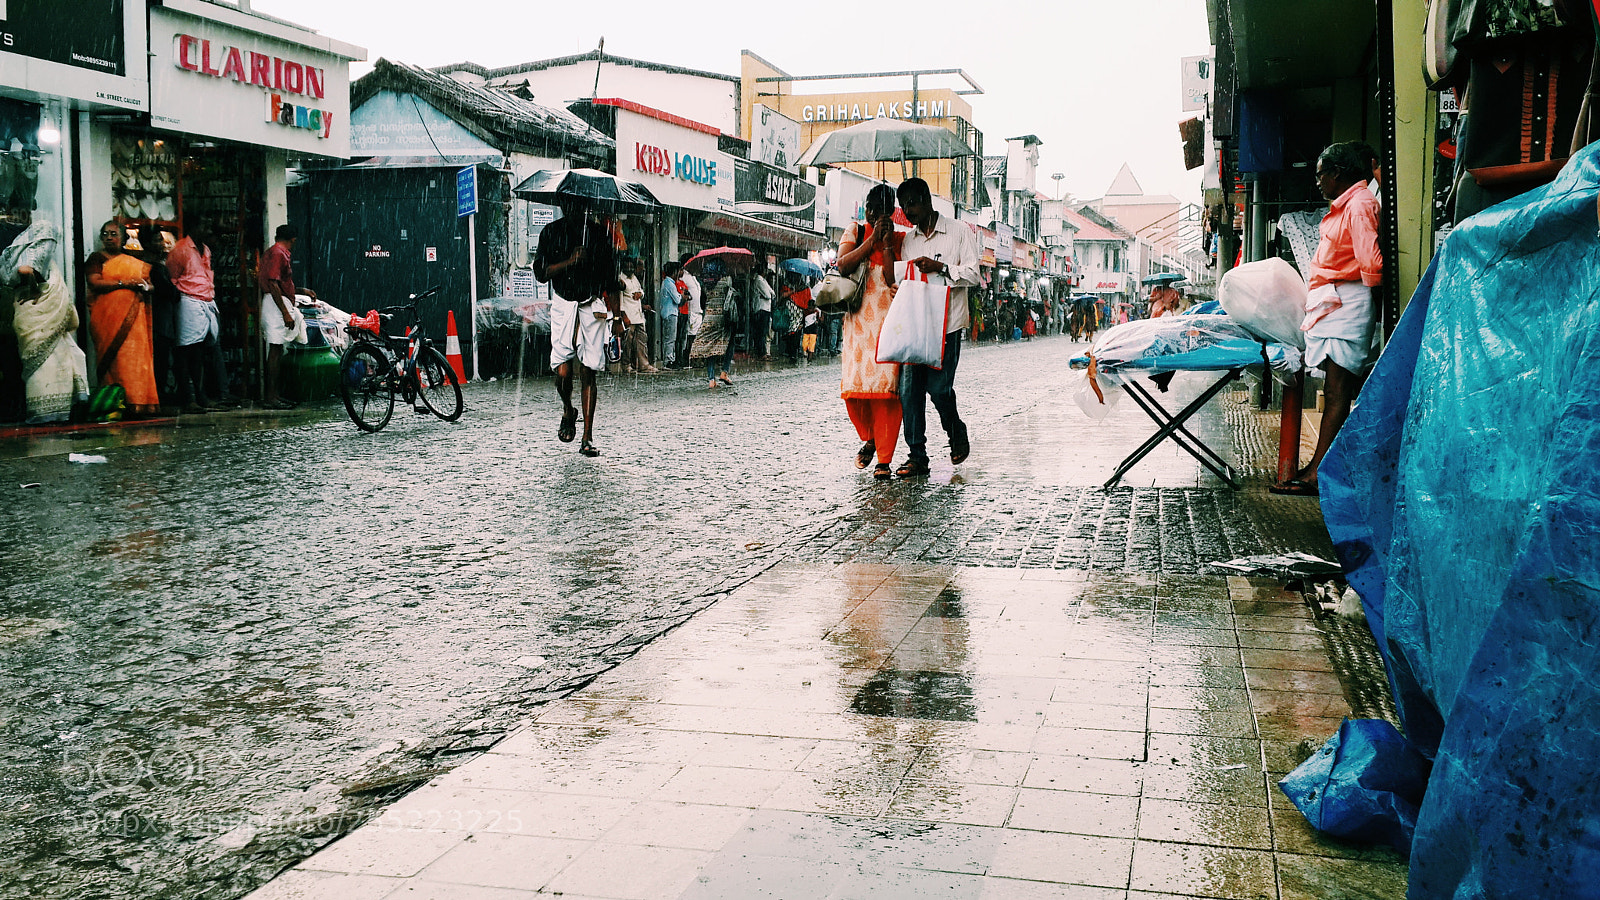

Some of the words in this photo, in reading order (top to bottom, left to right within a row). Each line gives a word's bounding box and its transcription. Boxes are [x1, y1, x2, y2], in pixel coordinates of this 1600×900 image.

[0, 31, 14, 46] S
[173, 33, 325, 99] CLARION
[265, 92, 333, 138] Fancy
[802, 99, 951, 122] GRIHALAKSHMI
[634, 142, 671, 176] KIDS
[674, 151, 717, 186] HOUSE
[765, 172, 796, 206] ASOKA
